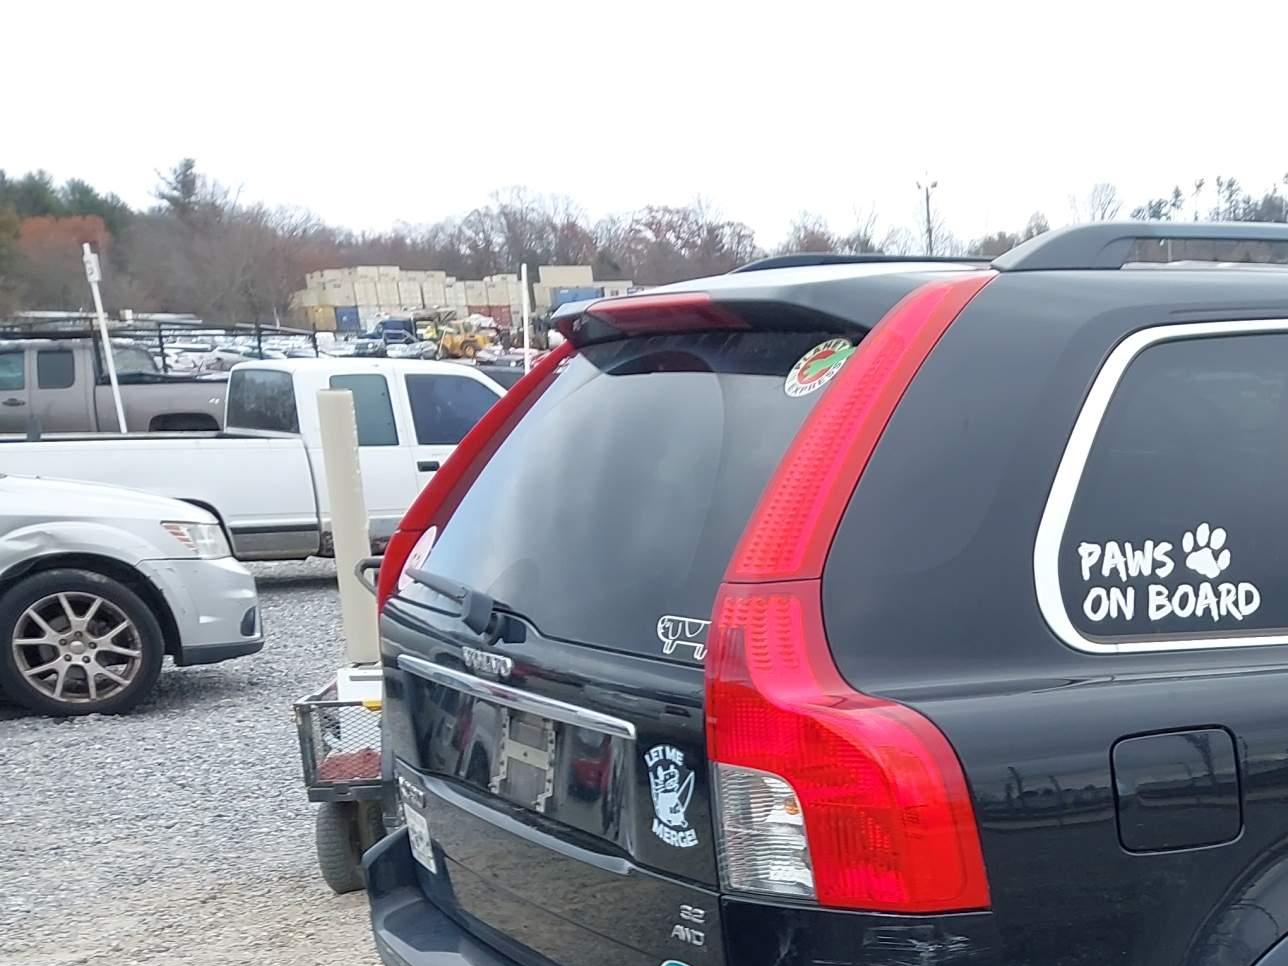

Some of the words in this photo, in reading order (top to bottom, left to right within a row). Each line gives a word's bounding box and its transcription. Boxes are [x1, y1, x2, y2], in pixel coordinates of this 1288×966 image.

[1077, 539, 1175, 582] PAWS
[1083, 586, 1135, 621] ON
[1148, 581, 1261, 622] BOARD
[462, 645, 513, 677] VOLVO
[644, 746, 665, 768] LET
[665, 746, 685, 767] ME
